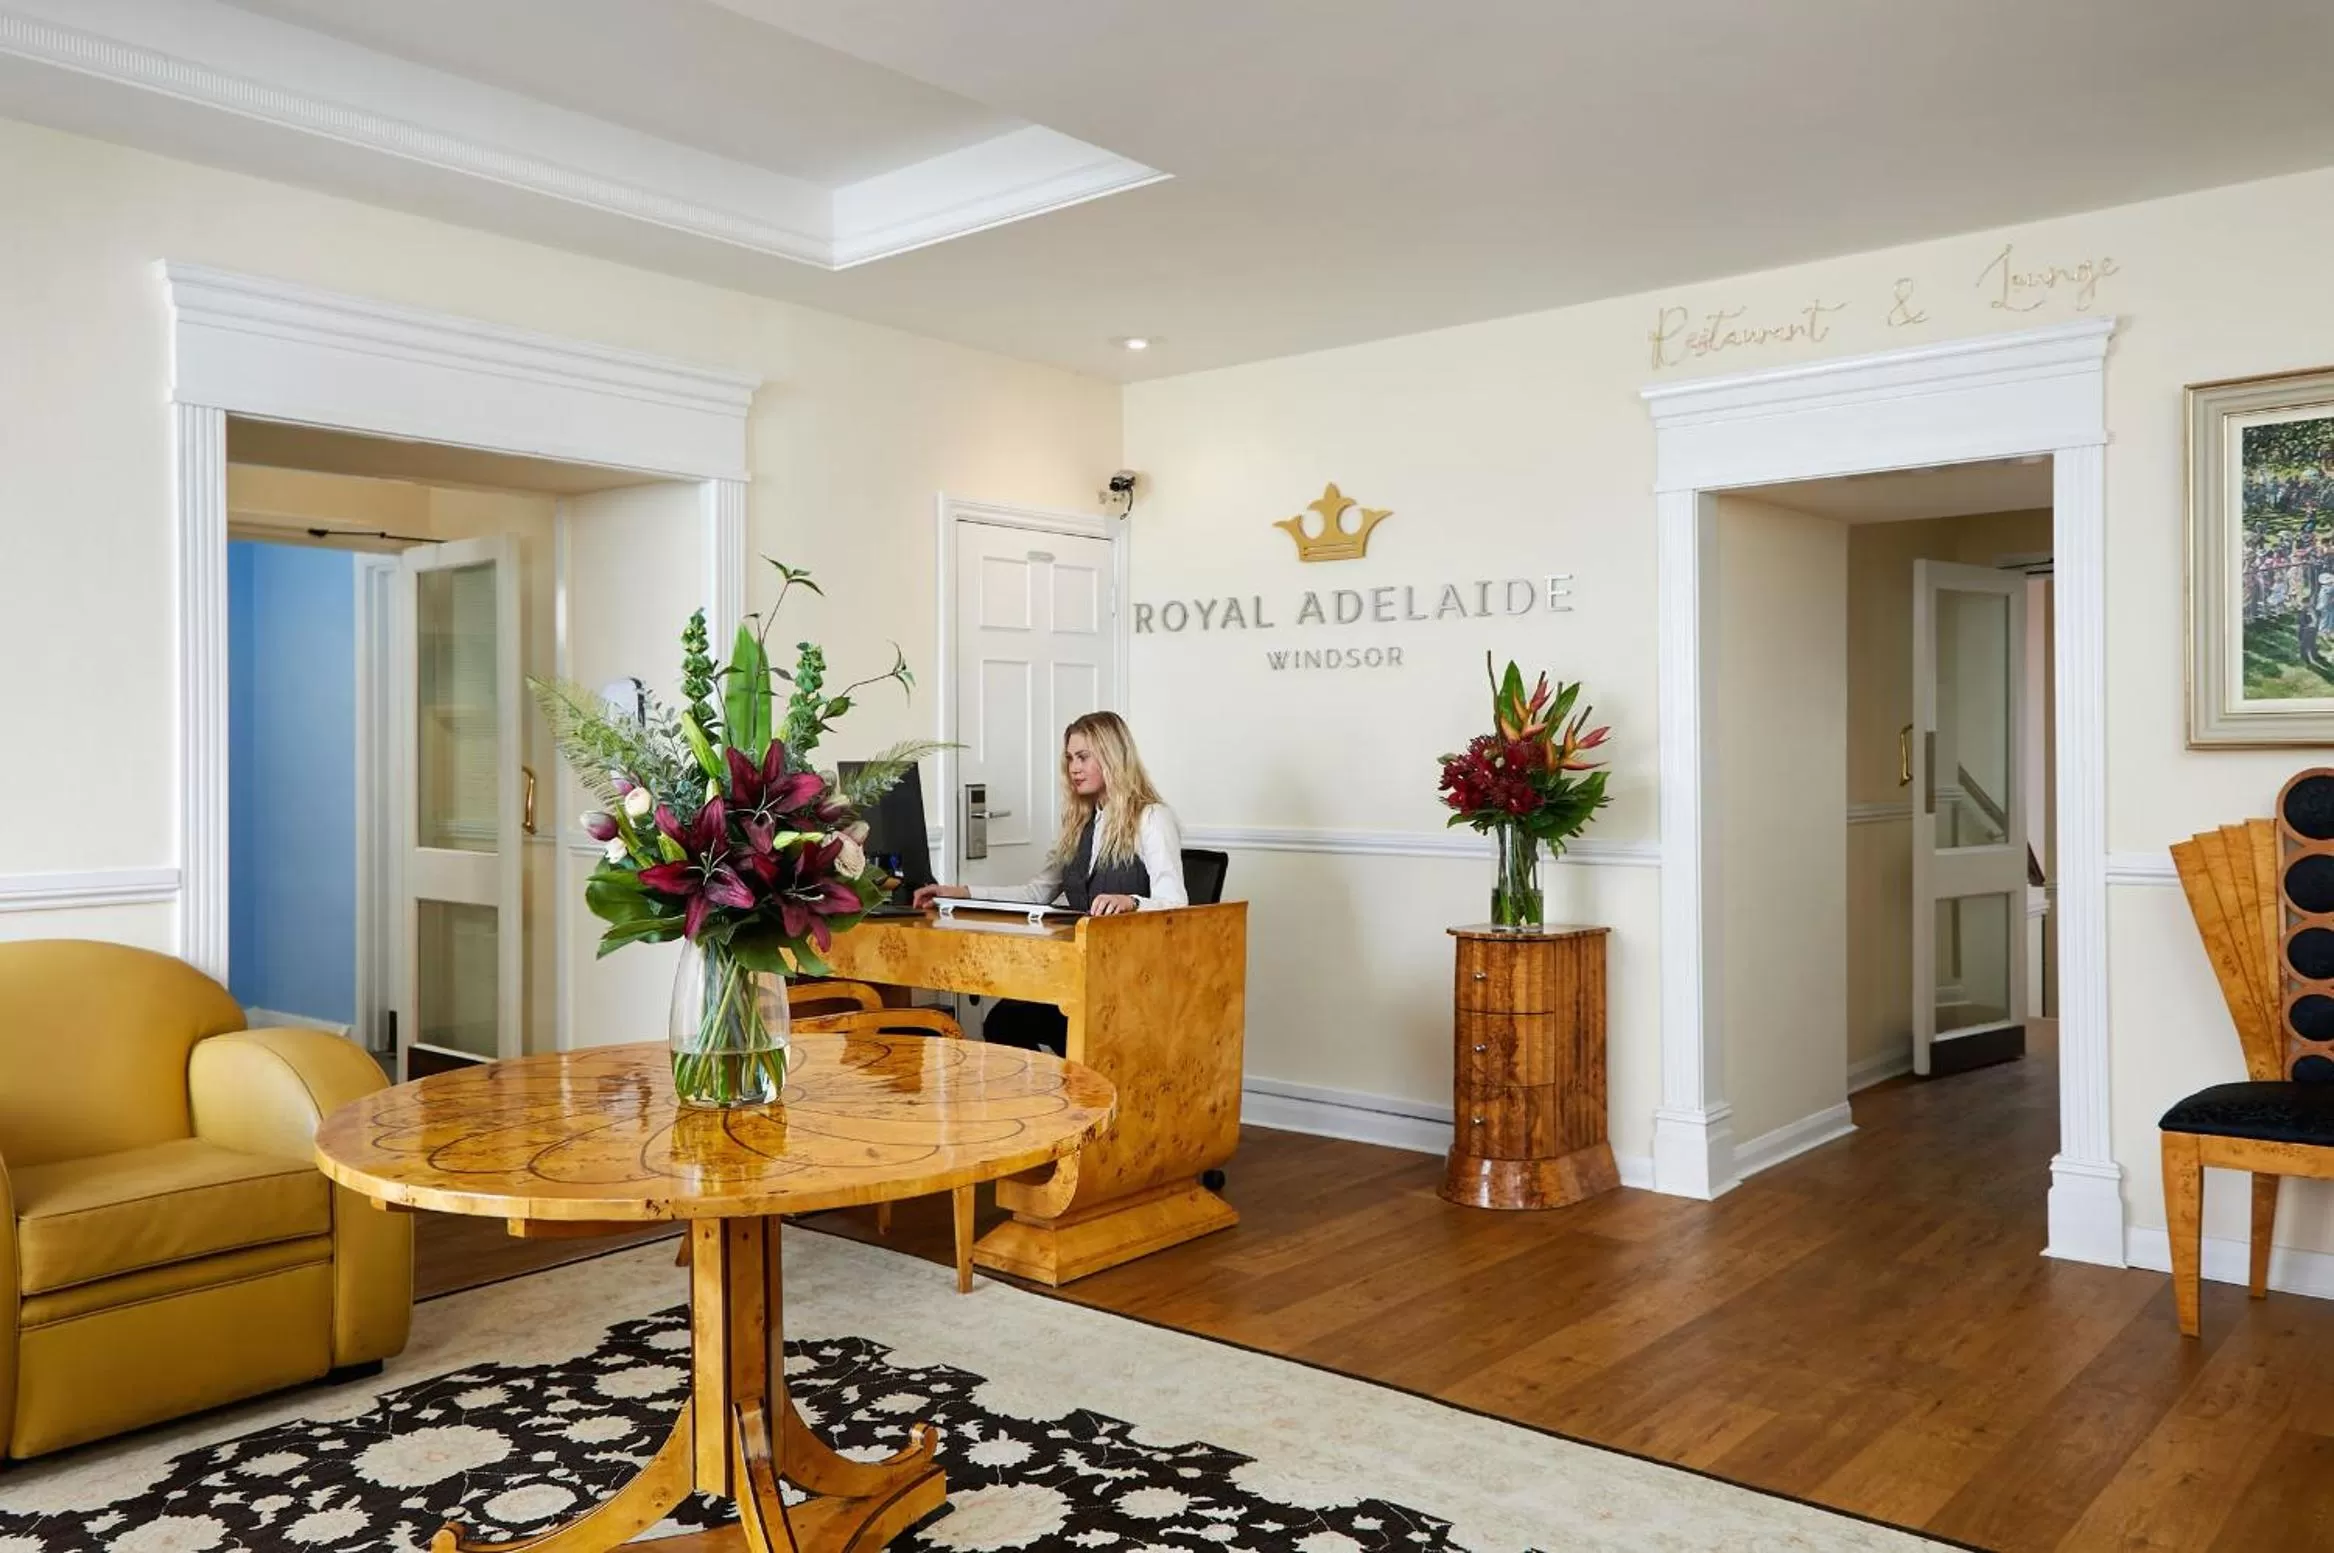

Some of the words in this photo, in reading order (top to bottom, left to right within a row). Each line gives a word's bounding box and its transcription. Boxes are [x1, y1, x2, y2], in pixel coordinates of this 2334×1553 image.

[1886, 277, 1930, 327] &
[1975, 243, 2121, 312] Lounge
[1133, 595, 1275, 634] ROYAL
[1296, 573, 1575, 625] ADELAIDE
[1267, 646, 1405, 671] WINDSOR
